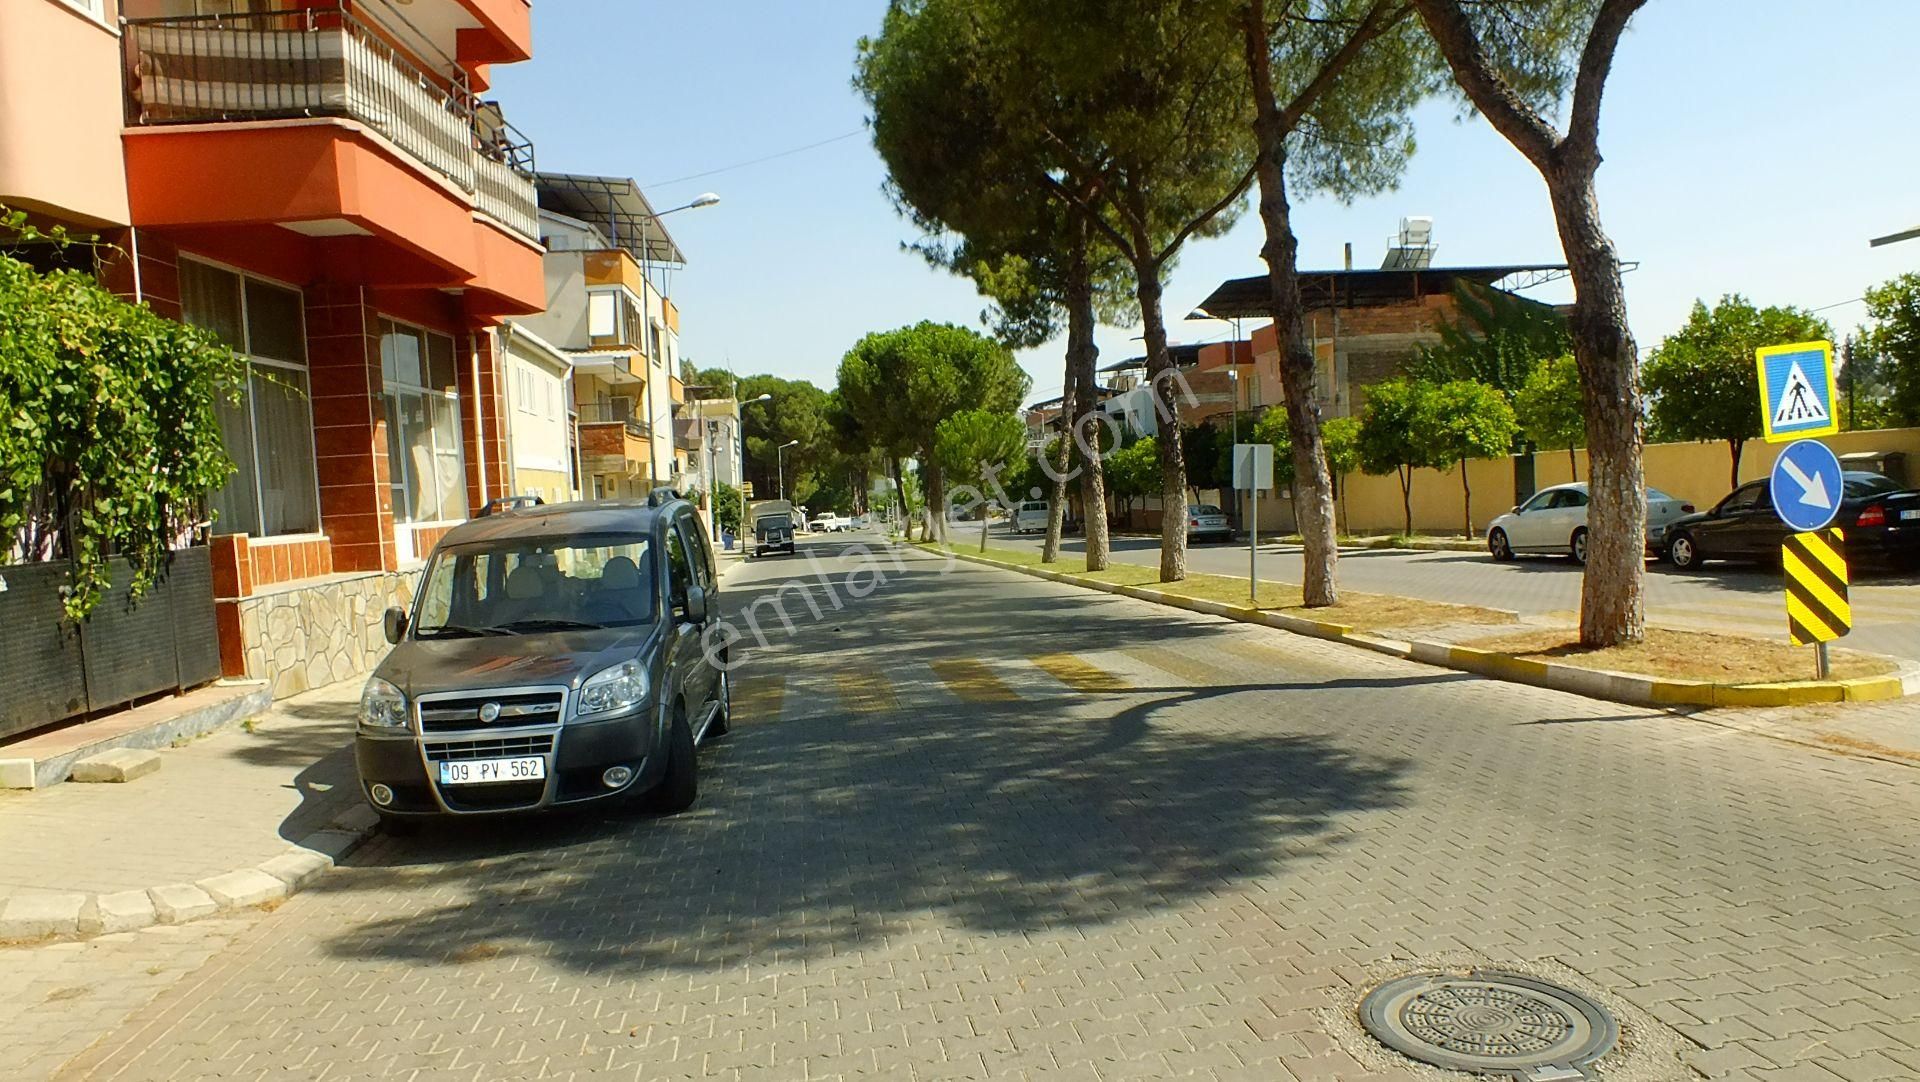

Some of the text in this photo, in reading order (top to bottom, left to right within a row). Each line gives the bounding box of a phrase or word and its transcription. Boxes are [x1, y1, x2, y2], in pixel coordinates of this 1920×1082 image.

[451, 760, 538, 781] 09 PV 562
